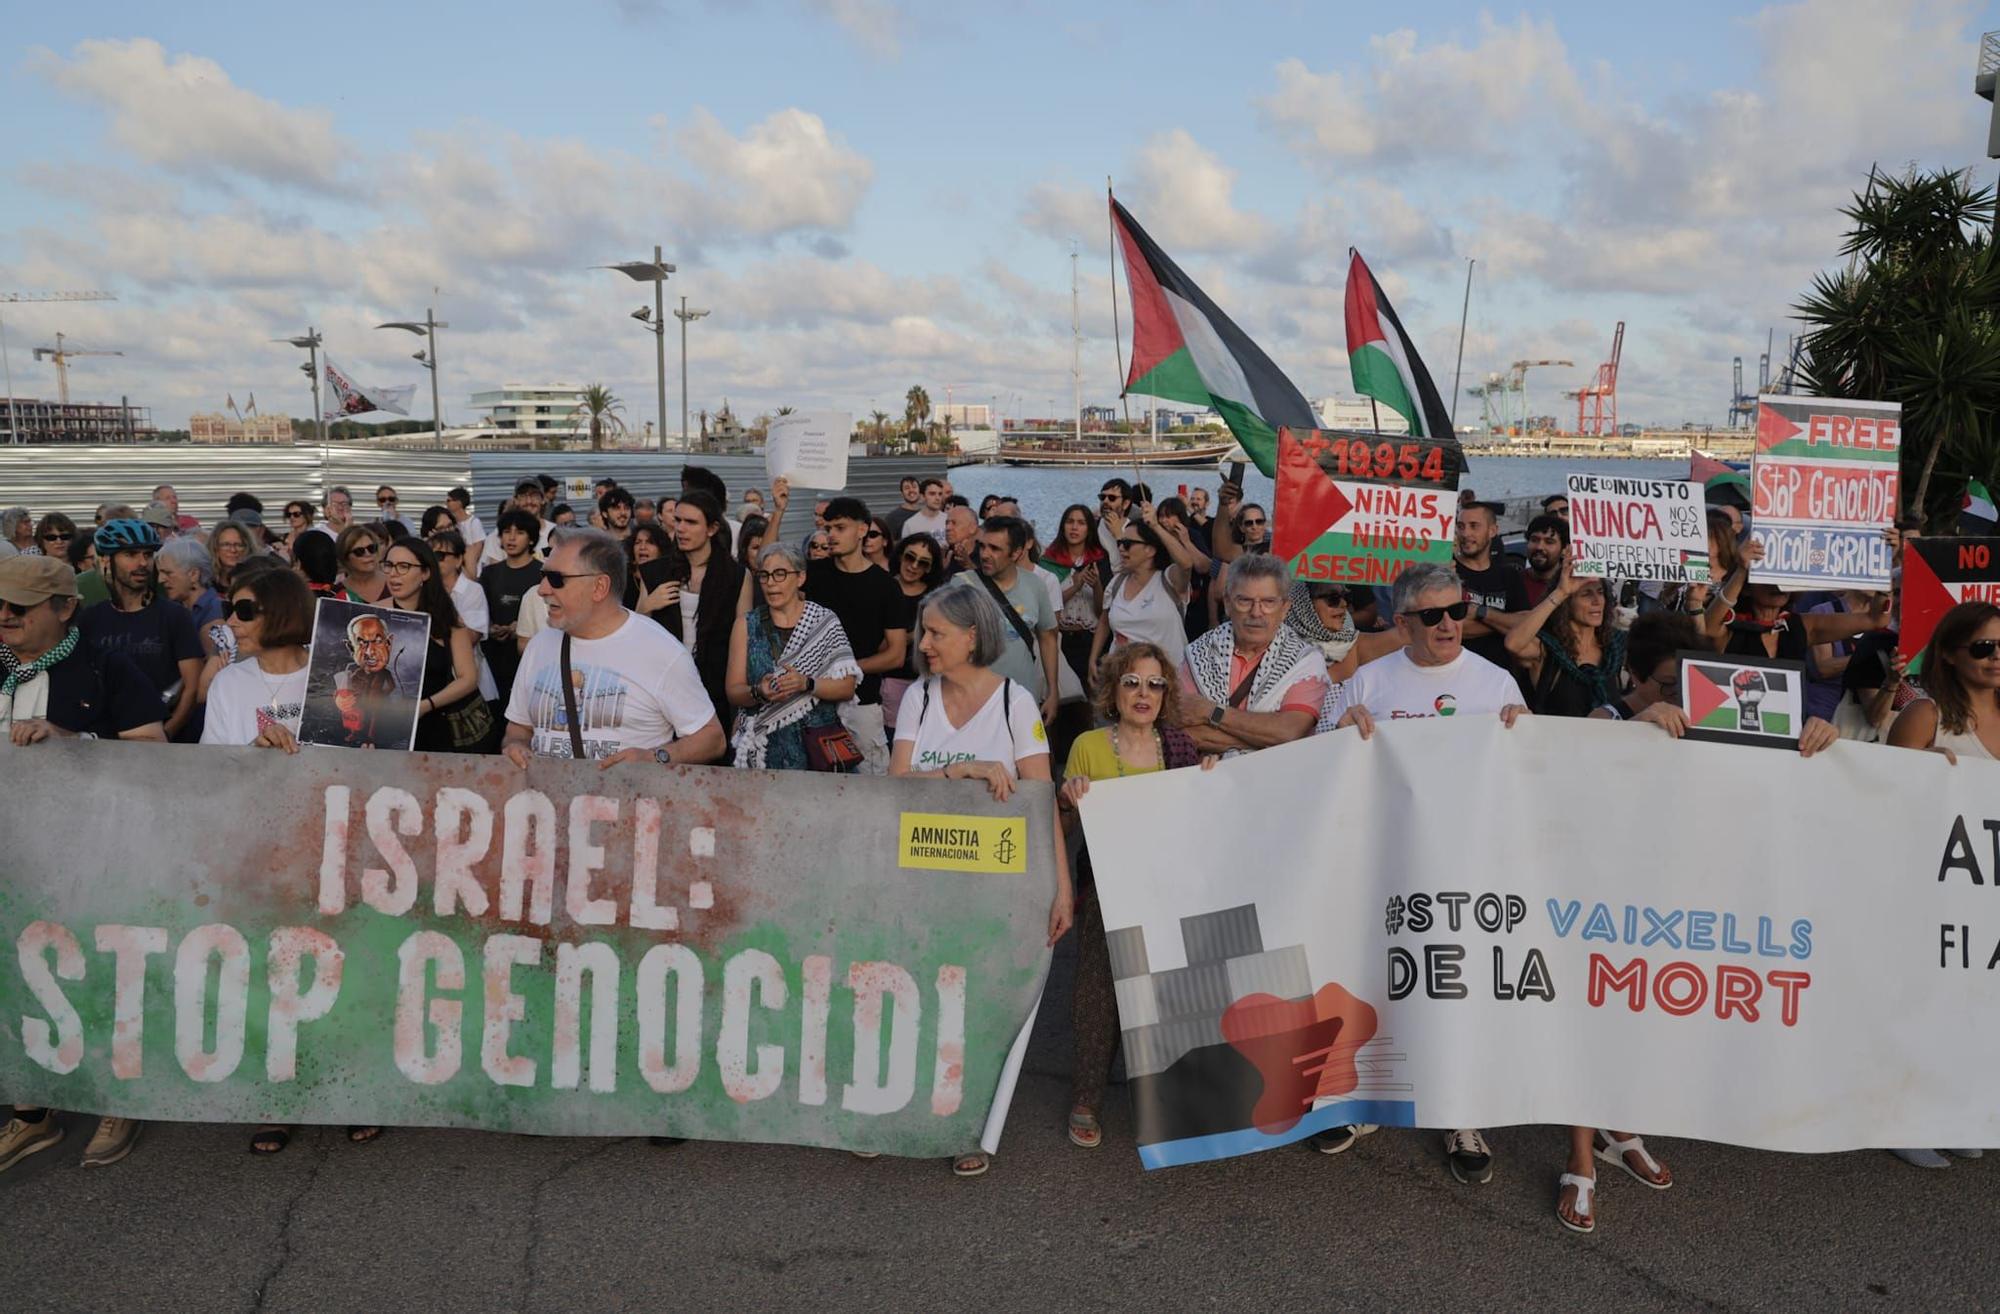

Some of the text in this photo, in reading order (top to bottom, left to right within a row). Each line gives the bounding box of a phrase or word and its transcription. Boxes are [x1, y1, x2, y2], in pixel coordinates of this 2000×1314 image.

[1807, 414, 1898, 452] FREE
[1303, 429, 1444, 482] +19.954
[1568, 475, 1689, 500] QUE LO INJUSTO
[1438, 514, 1453, 540] Y
[1571, 498, 1664, 541] NUNCA
[1670, 506, 1698, 523] NOS
[1670, 521, 1702, 538] SEA
[1572, 540, 1678, 565] INDIFERENTE
[1958, 544, 1990, 569] NO
[1606, 561, 1689, 581] PALESTINA
[911, 827, 980, 847] AMNISTIA
[319, 785, 716, 932] ISRAEL:
[910, 847, 980, 861] INTERNACIONAL
[1386, 892, 1813, 960] #STOP VAIXELLS
[1940, 924, 1970, 969] FI
[1387, 944, 1812, 1028] DE LA MORT
[16, 920, 968, 1117] STOP GENOCIDI
